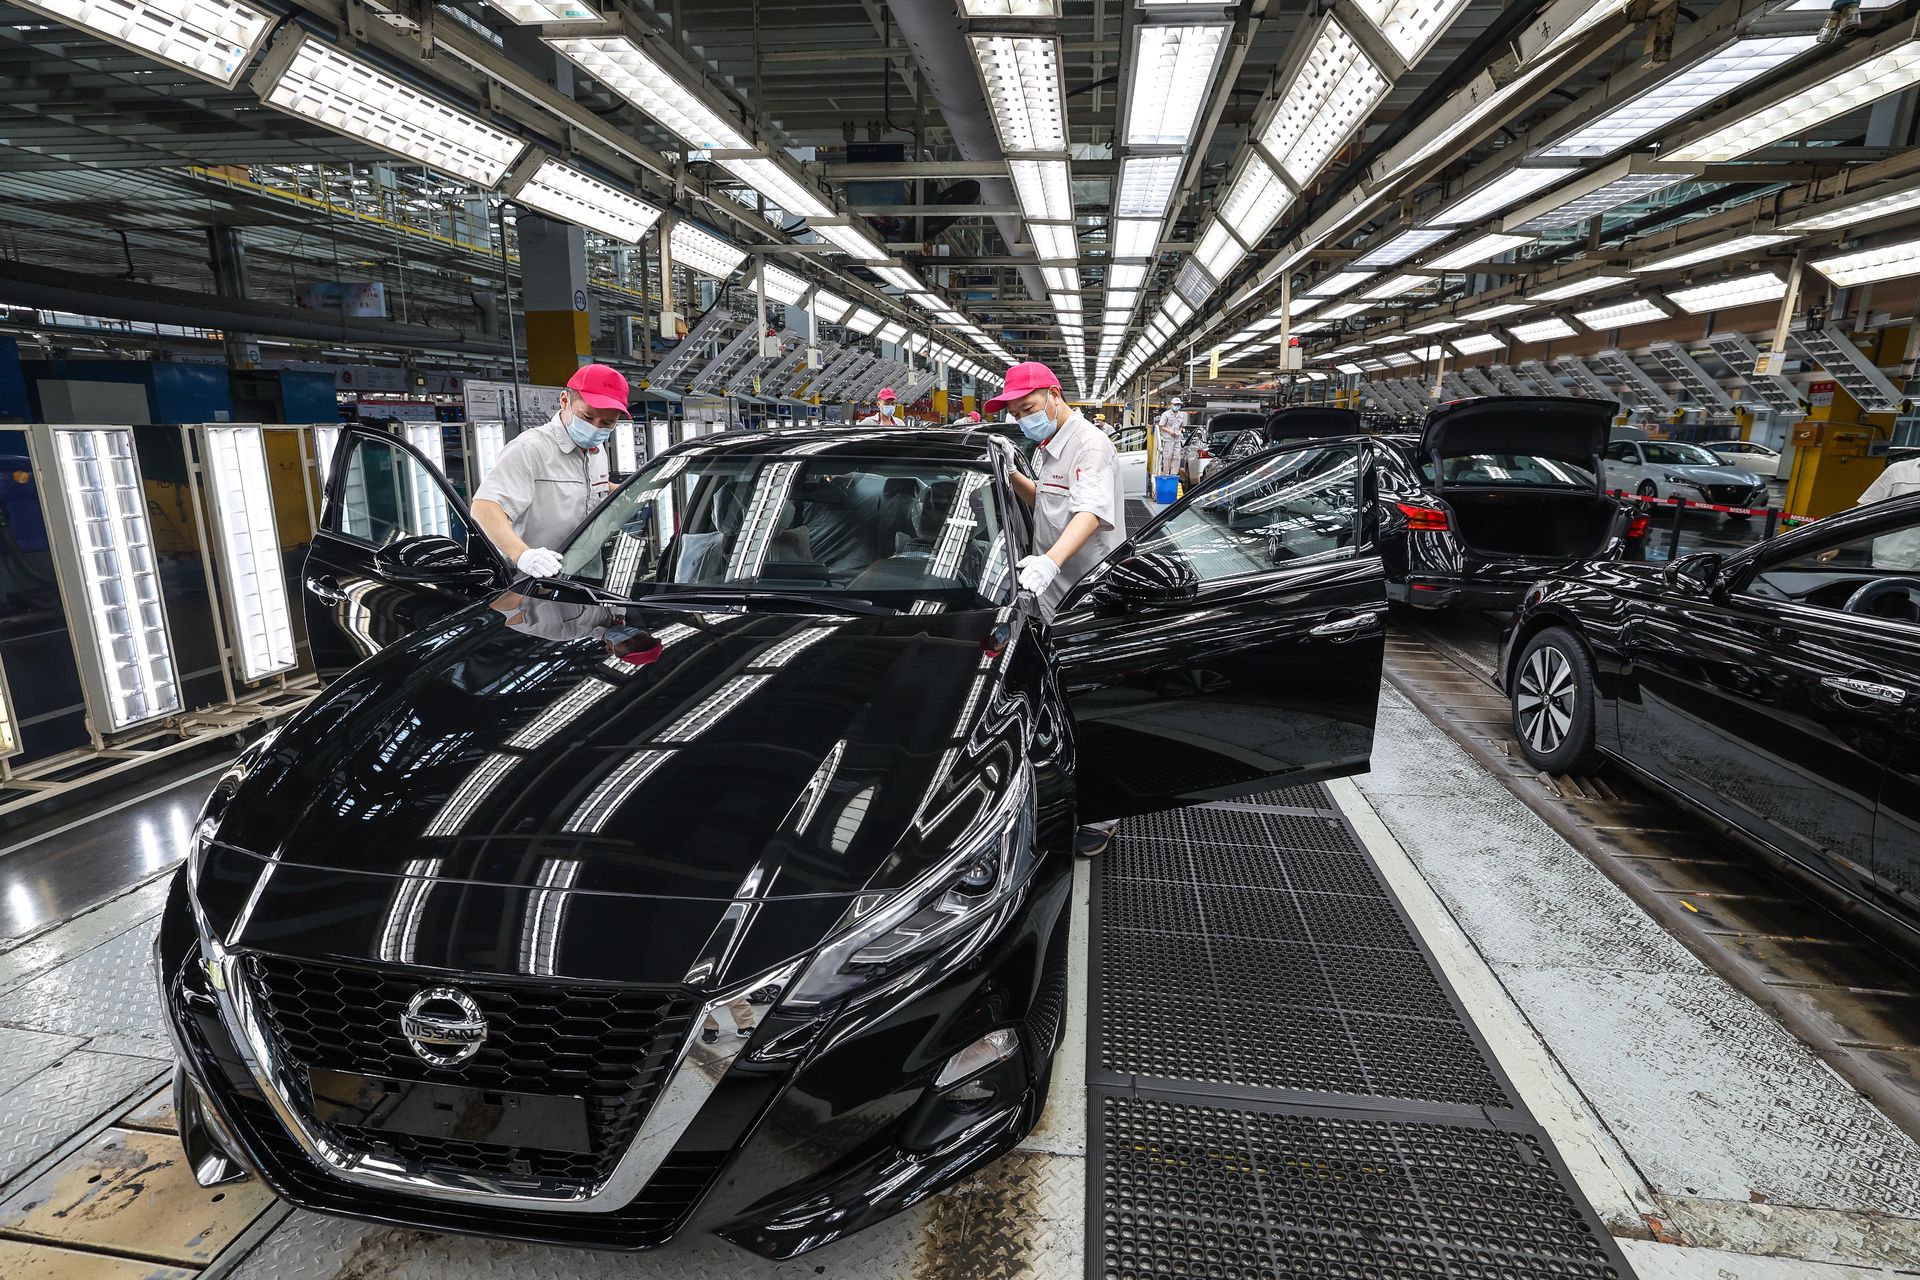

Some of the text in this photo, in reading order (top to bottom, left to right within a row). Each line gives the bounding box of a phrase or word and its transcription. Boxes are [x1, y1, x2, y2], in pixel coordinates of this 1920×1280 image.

[1694, 502, 1714, 510] NISSAN
[1790, 514, 1815, 523] NISSAN
[405, 1022, 475, 1041] NISSAN
